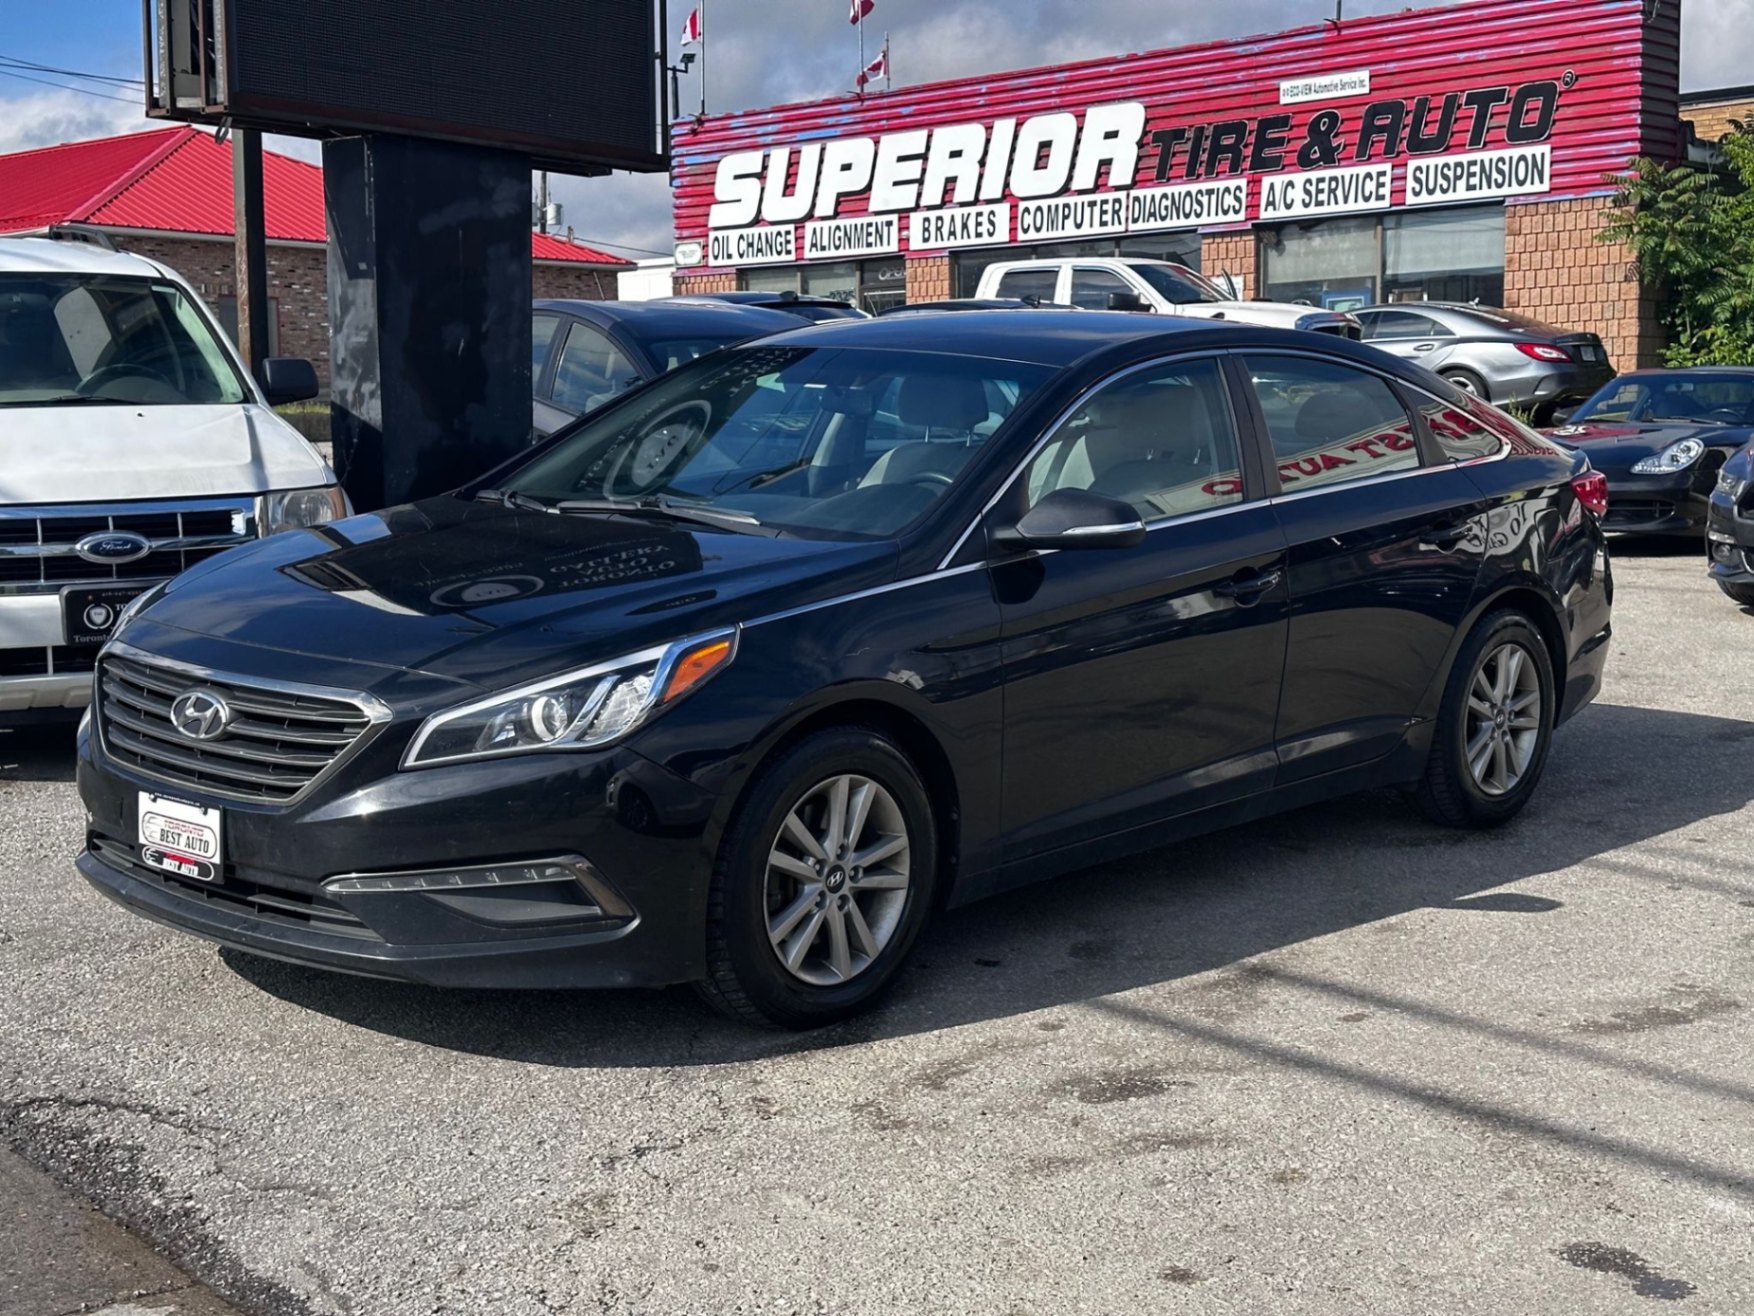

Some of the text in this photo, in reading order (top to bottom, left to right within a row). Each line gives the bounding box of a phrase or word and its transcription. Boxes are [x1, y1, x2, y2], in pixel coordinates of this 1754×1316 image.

[1339, 77, 1357, 91] Service
[708, 102, 1147, 230] SUPERIOR
[1151, 113, 1293, 183] TIRE
[1296, 109, 1345, 170] &
[1354, 80, 1559, 161] AUTO
[1264, 170, 1387, 212] A/C SERVICE
[1411, 152, 1546, 198] SUSPENSION
[921, 210, 997, 243] BRAKES
[1020, 187, 1244, 235] COMPUTER DIAGNOSTICS
[712, 230, 792, 261] OIL CHANGE
[809, 220, 894, 253] ALIGNMENT
[99, 540, 132, 551] Ford
[160, 828, 210, 854] BEST AUTO
